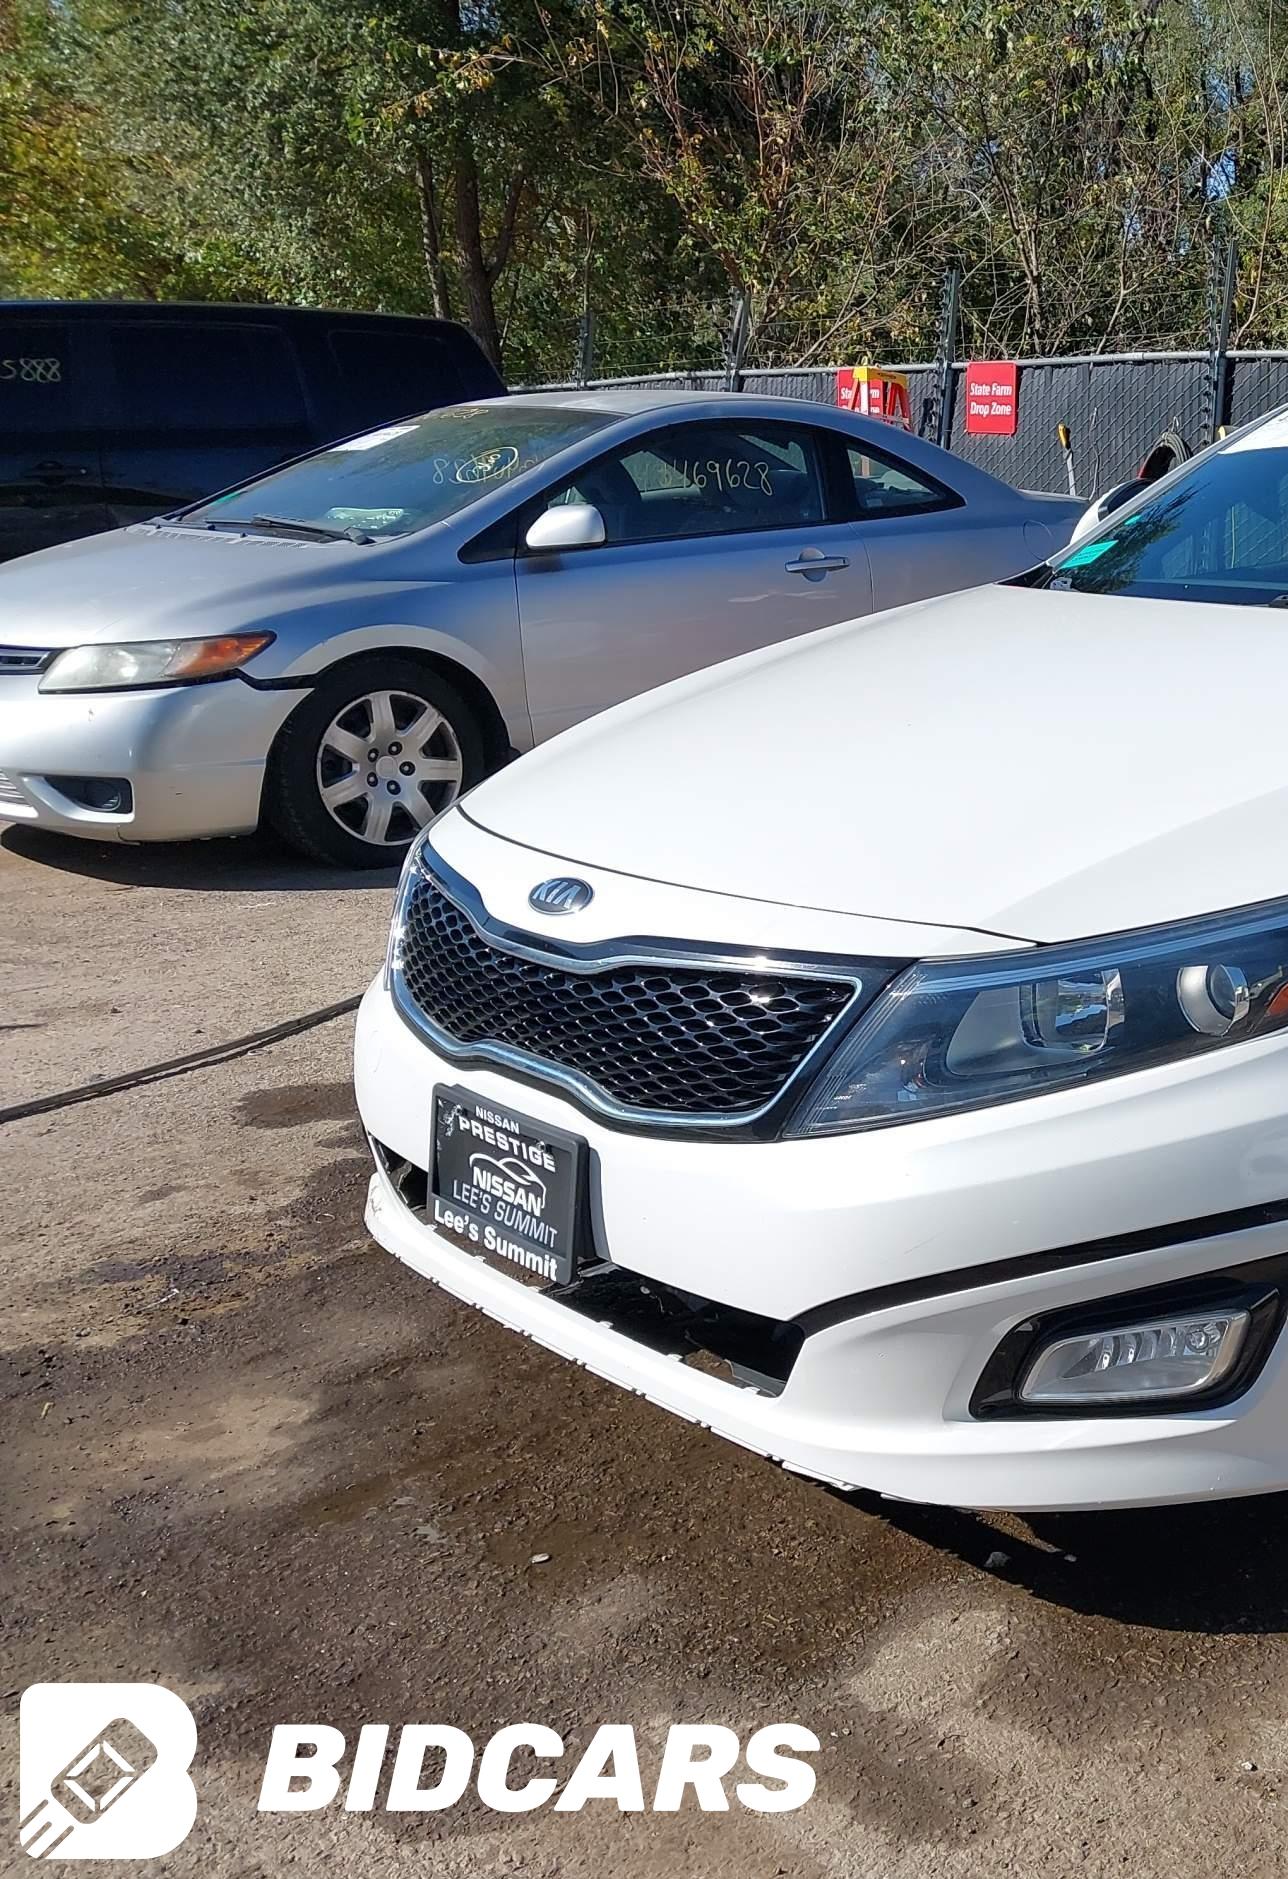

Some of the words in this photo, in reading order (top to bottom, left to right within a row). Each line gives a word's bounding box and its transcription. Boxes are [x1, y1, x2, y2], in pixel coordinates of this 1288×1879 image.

[970, 382, 990, 396] State
[991, 382, 1012, 396] Farm
[970, 401, 990, 418] Drop
[990, 401, 1012, 416] Zone
[532, 880, 581, 909] KIA
[475, 1105, 520, 1135] NISSAN
[459, 1116, 556, 1173] PRESTIGE
[473, 1166, 542, 1217] NISSAN
[452, 1179, 492, 1214] LEE'S
[493, 1200, 558, 1249] SUMMIT
[433, 1199, 479, 1242] Lee's
[483, 1225, 558, 1282] Summit
